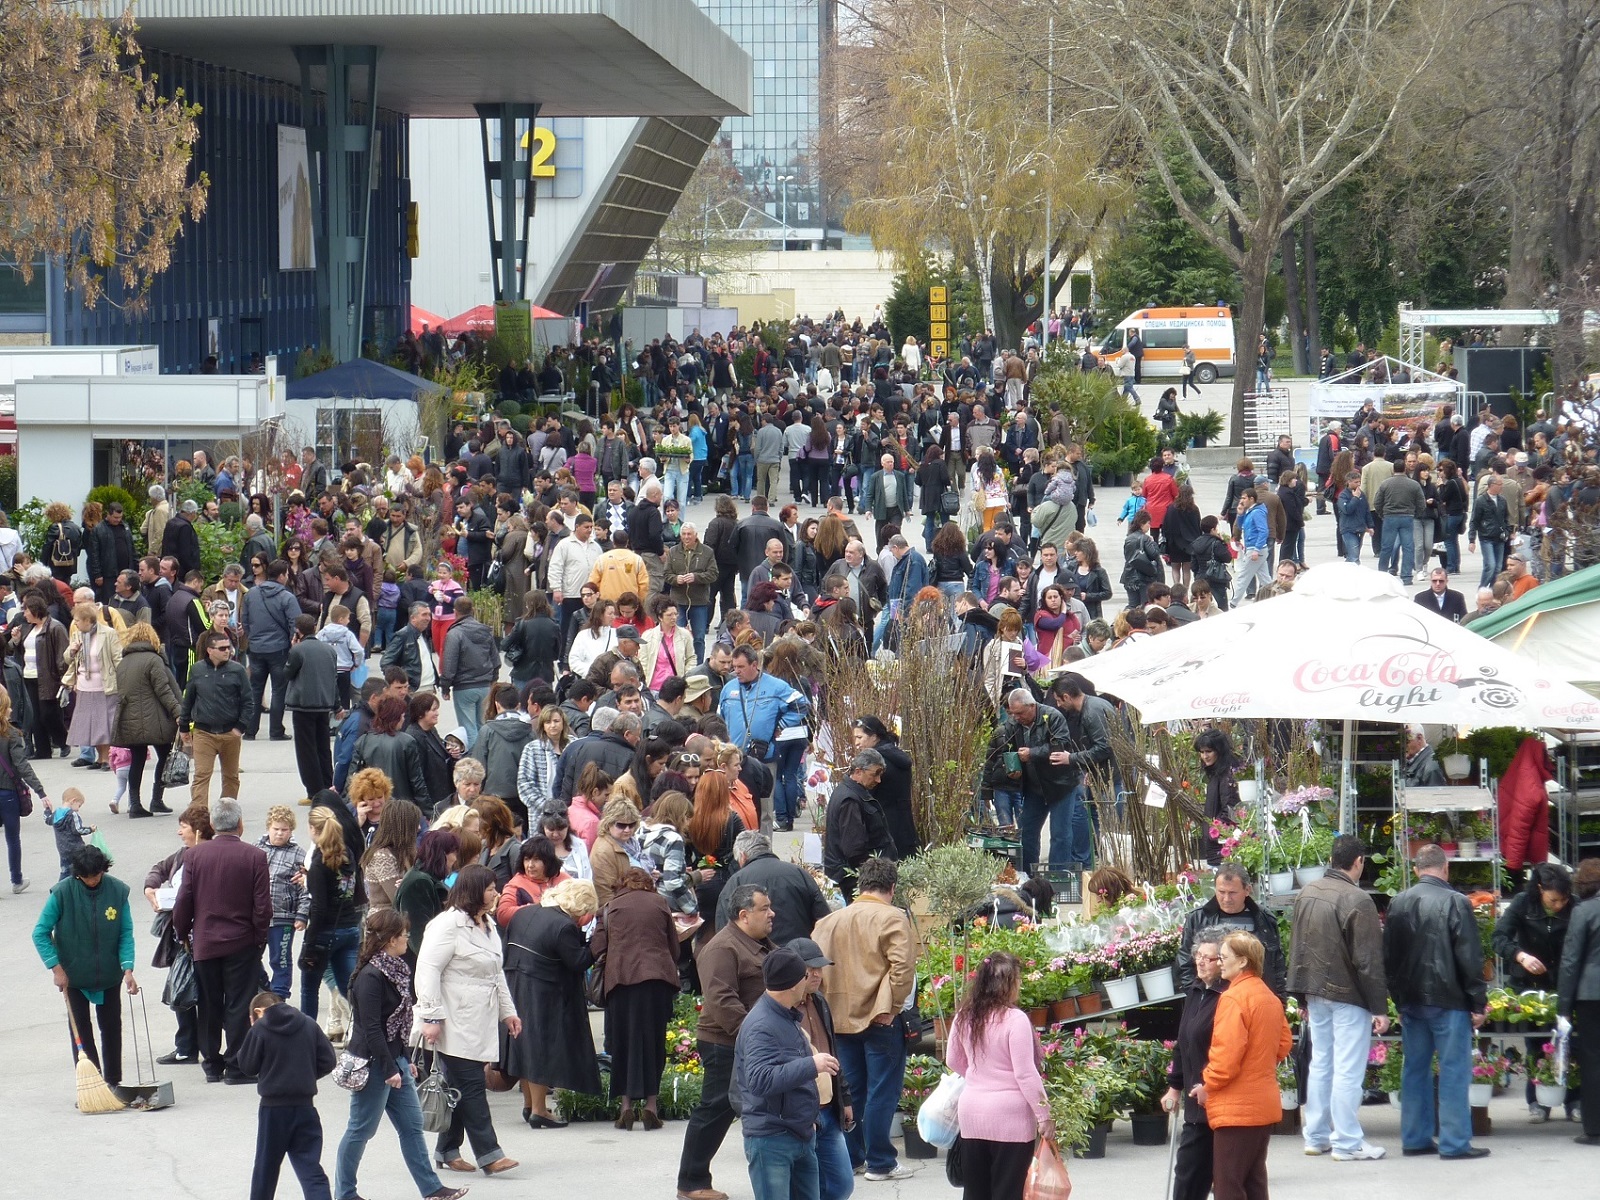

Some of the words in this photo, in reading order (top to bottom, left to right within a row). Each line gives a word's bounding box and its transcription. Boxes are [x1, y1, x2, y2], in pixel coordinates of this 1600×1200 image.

[520, 127, 556, 177] 2
[1145, 320, 1167, 328] СПЕШНА
[1169, 320, 1205, 328] МЕДИЦИНСКА
[1206, 320, 1227, 328] ПОМОЩ
[1356, 685, 1443, 713] light
[1212, 704, 1243, 715] light
[1566, 714, 1595, 725] light
